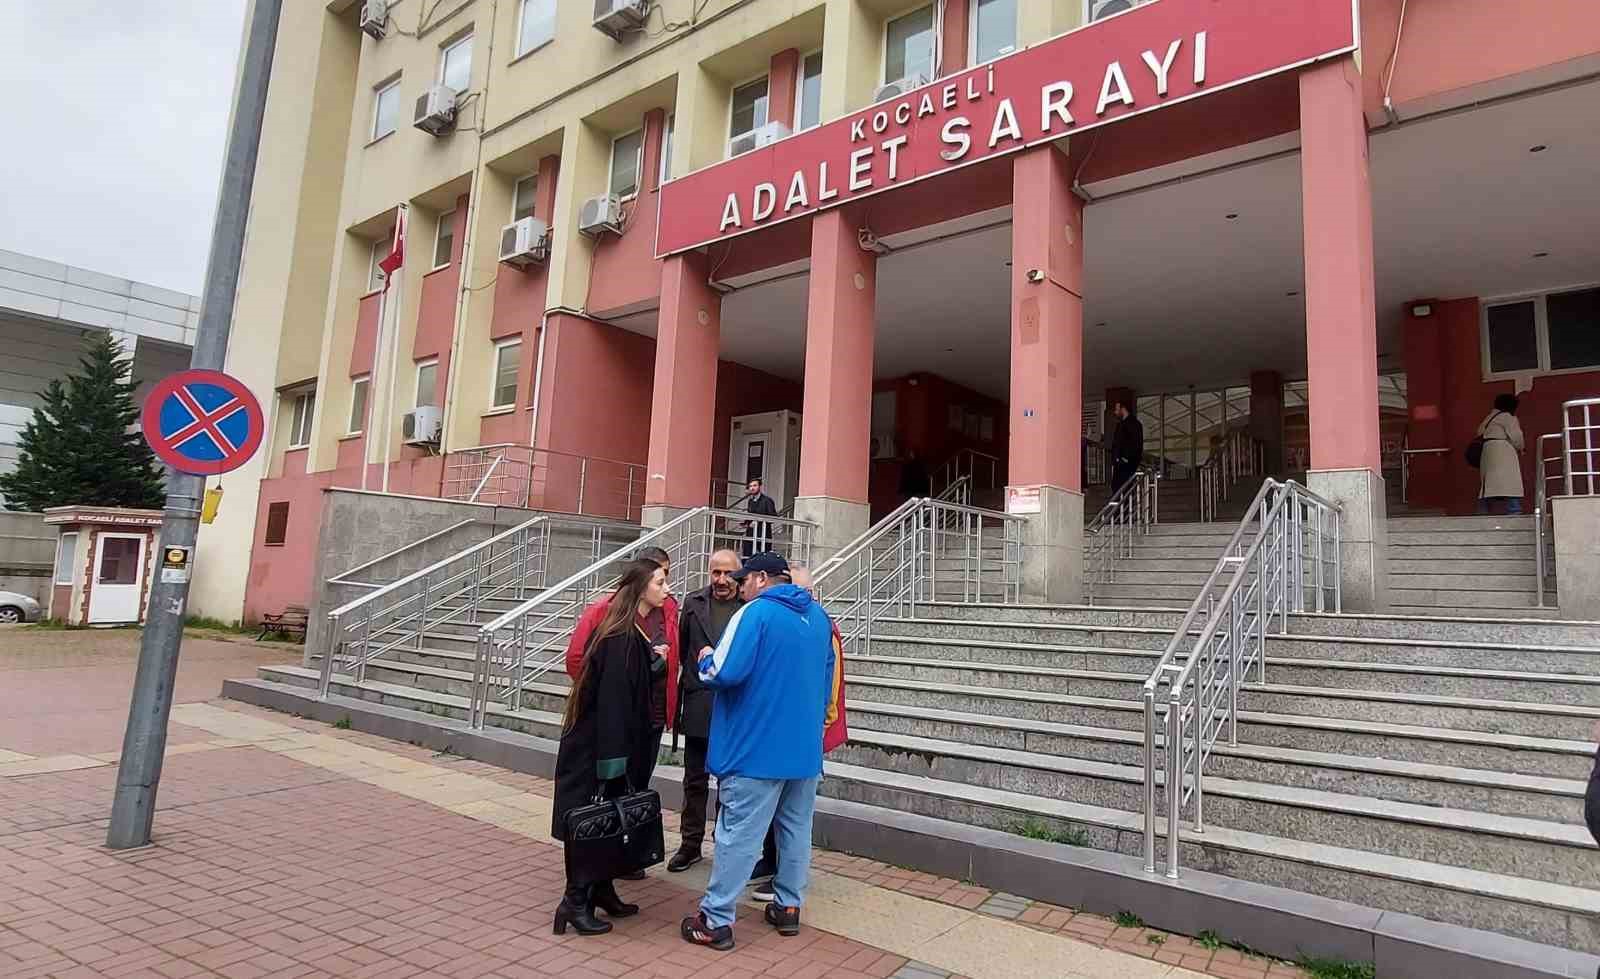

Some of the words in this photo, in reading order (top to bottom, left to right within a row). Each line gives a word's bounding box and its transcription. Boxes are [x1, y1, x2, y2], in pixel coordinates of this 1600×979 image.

[720, 135, 907, 231] ADALET
[940, 31, 1207, 161] SARAYI
[851, 65, 995, 142] KOCAELİ
